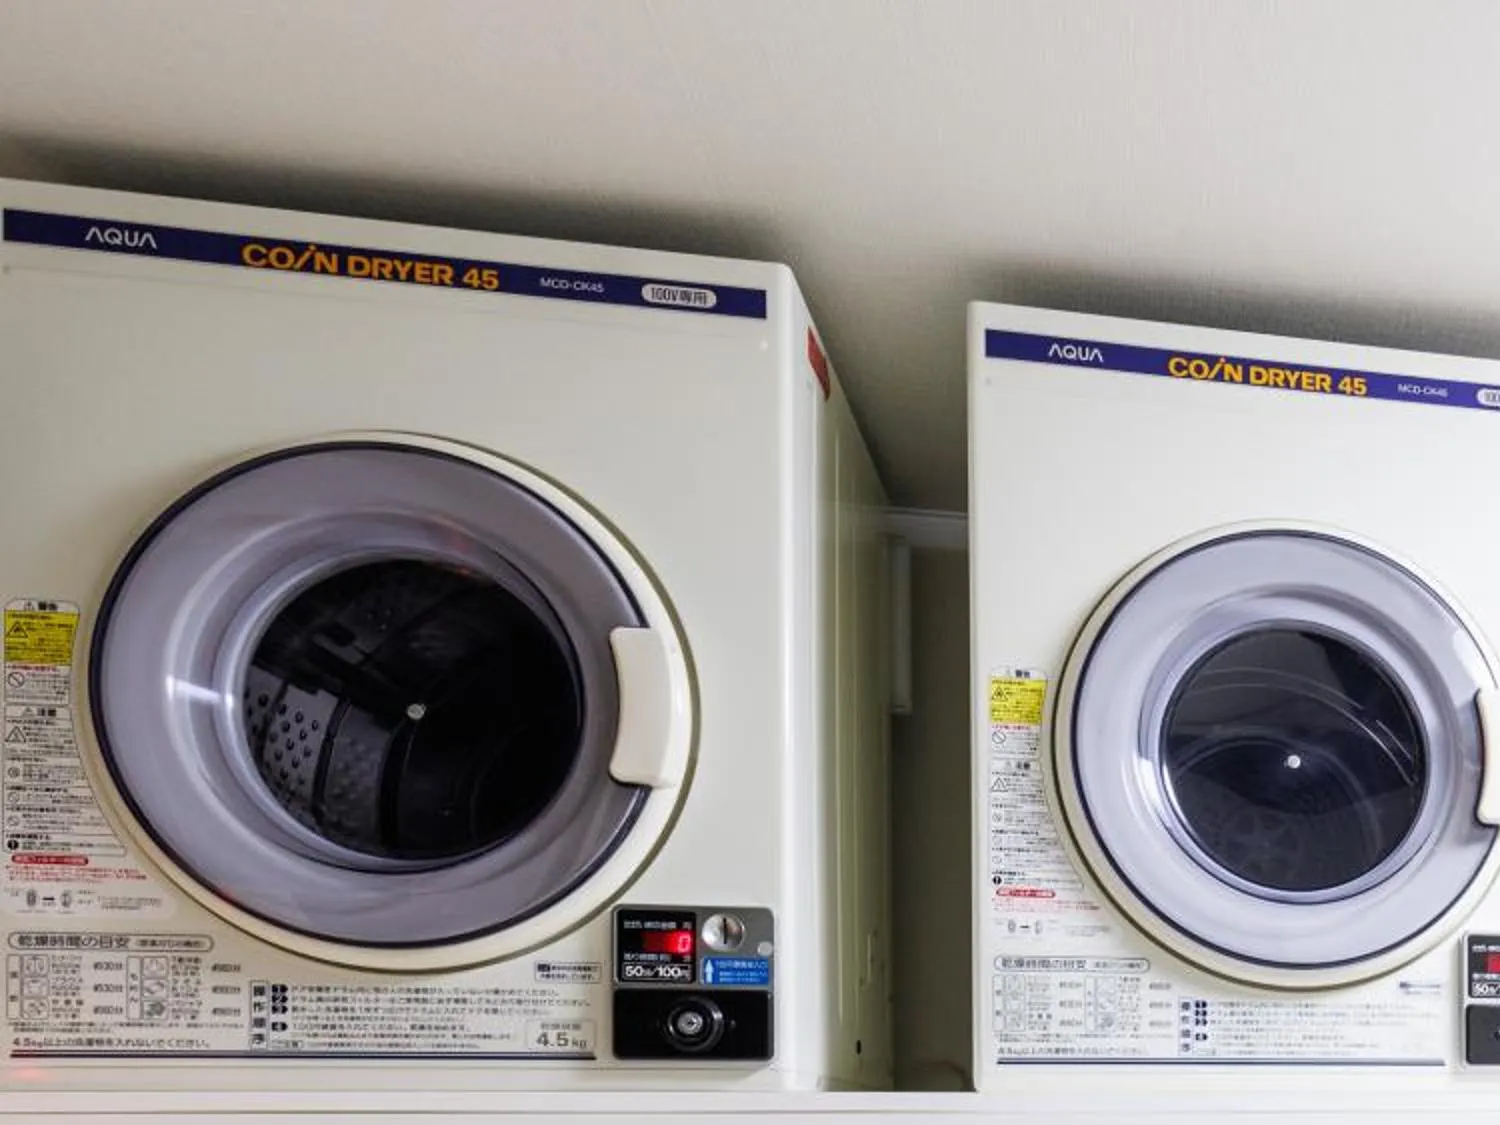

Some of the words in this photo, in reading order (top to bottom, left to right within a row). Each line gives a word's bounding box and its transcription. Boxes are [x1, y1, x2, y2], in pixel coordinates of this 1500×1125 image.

[85, 227, 157, 249] AQUA
[347, 255, 454, 285] DRYER
[463, 268, 499, 290] 45
[1048, 343, 1104, 362] AQUA
[1251, 367, 1332, 392] DRYER
[1338, 377, 1367, 396] 45
[678, 933, 692, 952] 0
